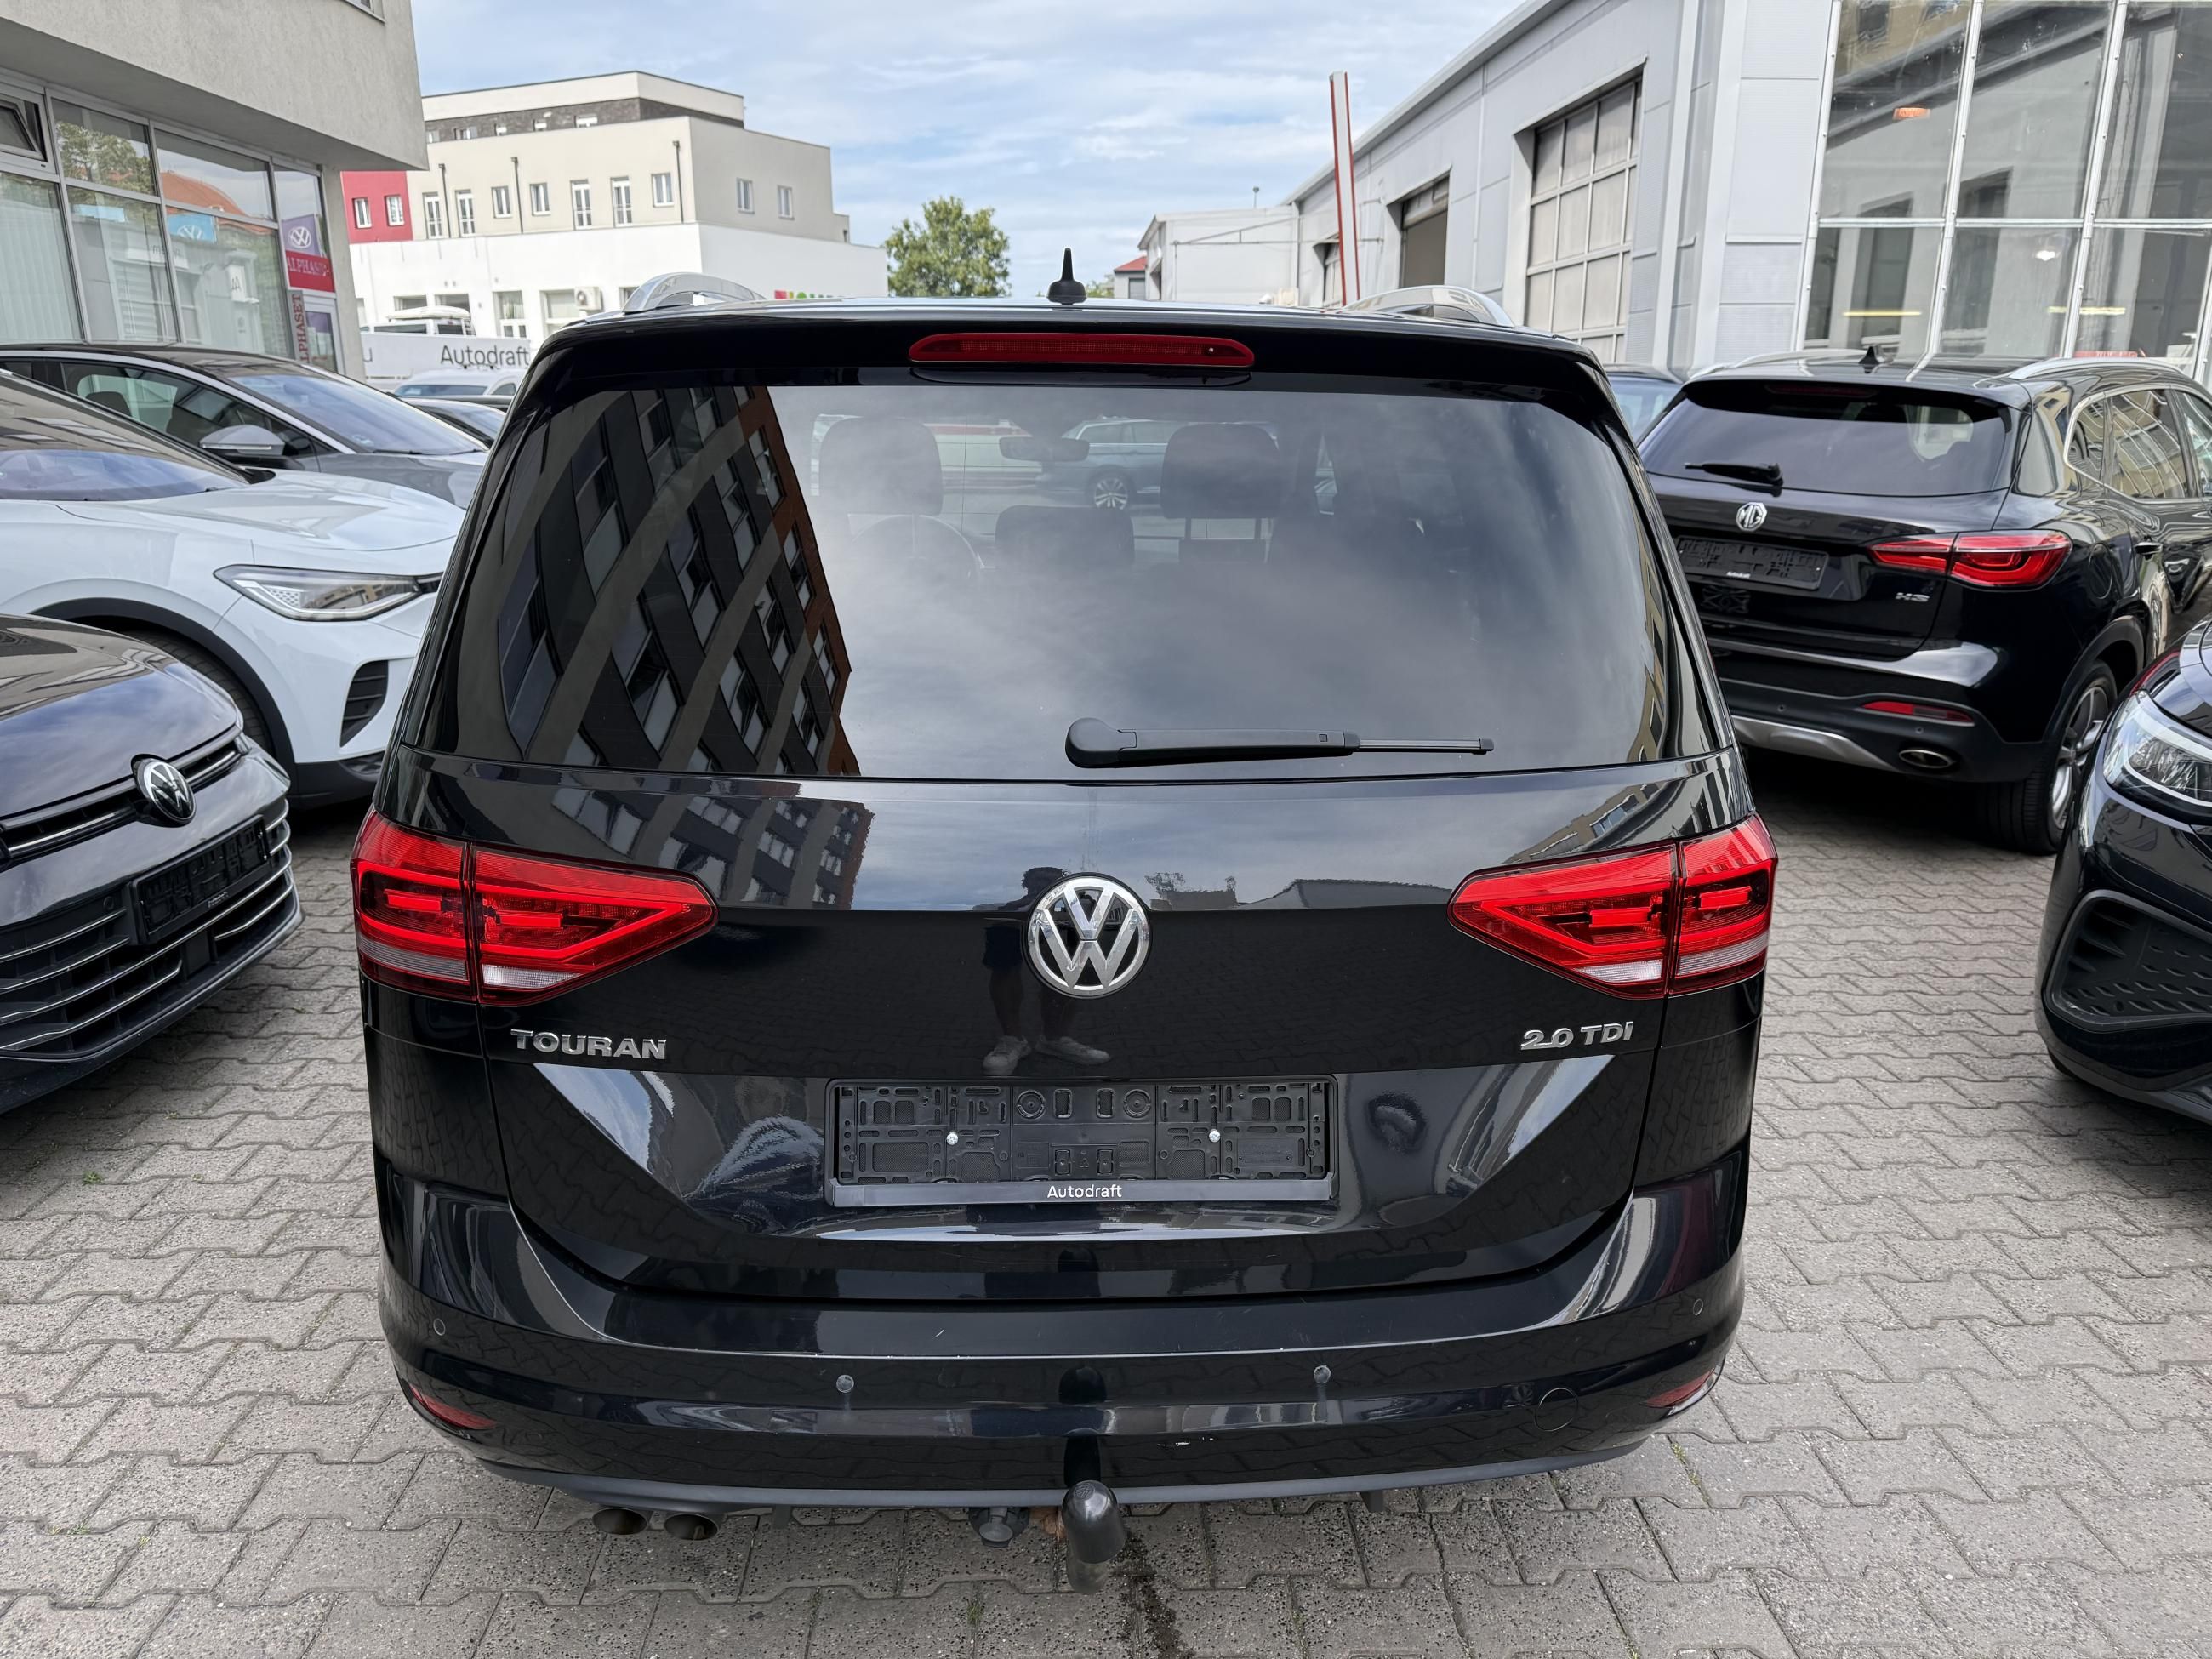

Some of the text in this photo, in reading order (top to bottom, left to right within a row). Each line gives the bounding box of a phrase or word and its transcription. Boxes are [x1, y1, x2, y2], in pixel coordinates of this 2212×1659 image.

[292, 294, 311, 363] LPHASET
[441, 345, 530, 366] Autodraft
[1736, 502, 1767, 532] MG
[510, 1028, 667, 1059] TOURAN
[1580, 1021, 1634, 1046] TDI
[1046, 1183, 1123, 1198] Autodraft
